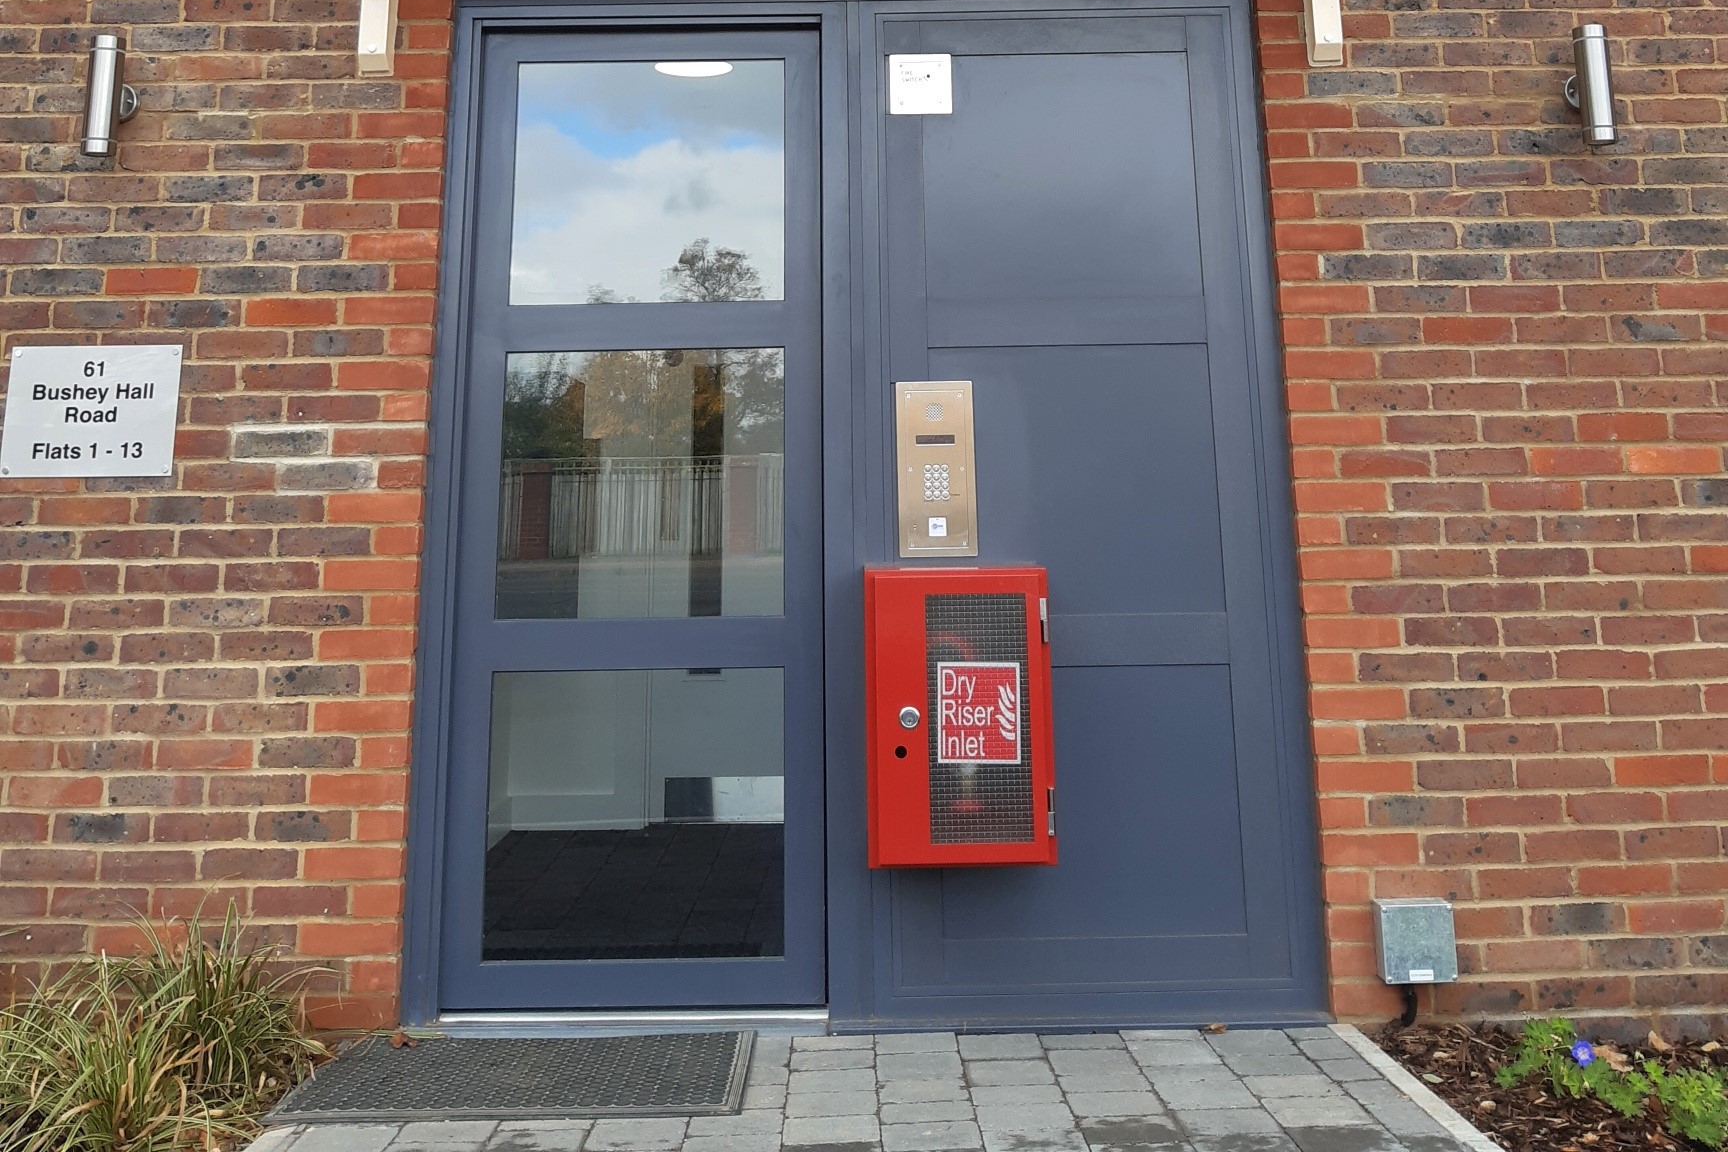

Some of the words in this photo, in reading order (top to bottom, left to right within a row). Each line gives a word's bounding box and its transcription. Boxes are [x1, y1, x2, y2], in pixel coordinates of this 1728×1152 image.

[83, 361, 105, 377] 61
[32, 384, 109, 404] Bushey
[115, 383, 155, 400] Hall
[64, 406, 118, 423] Road
[32, 442, 82, 459] Flats
[89, 442, 98, 459] 1
[120, 441, 143, 459] 13
[942, 668, 977, 703] Dry
[942, 698, 995, 727] Riser
[942, 729, 986, 757] Inlet
